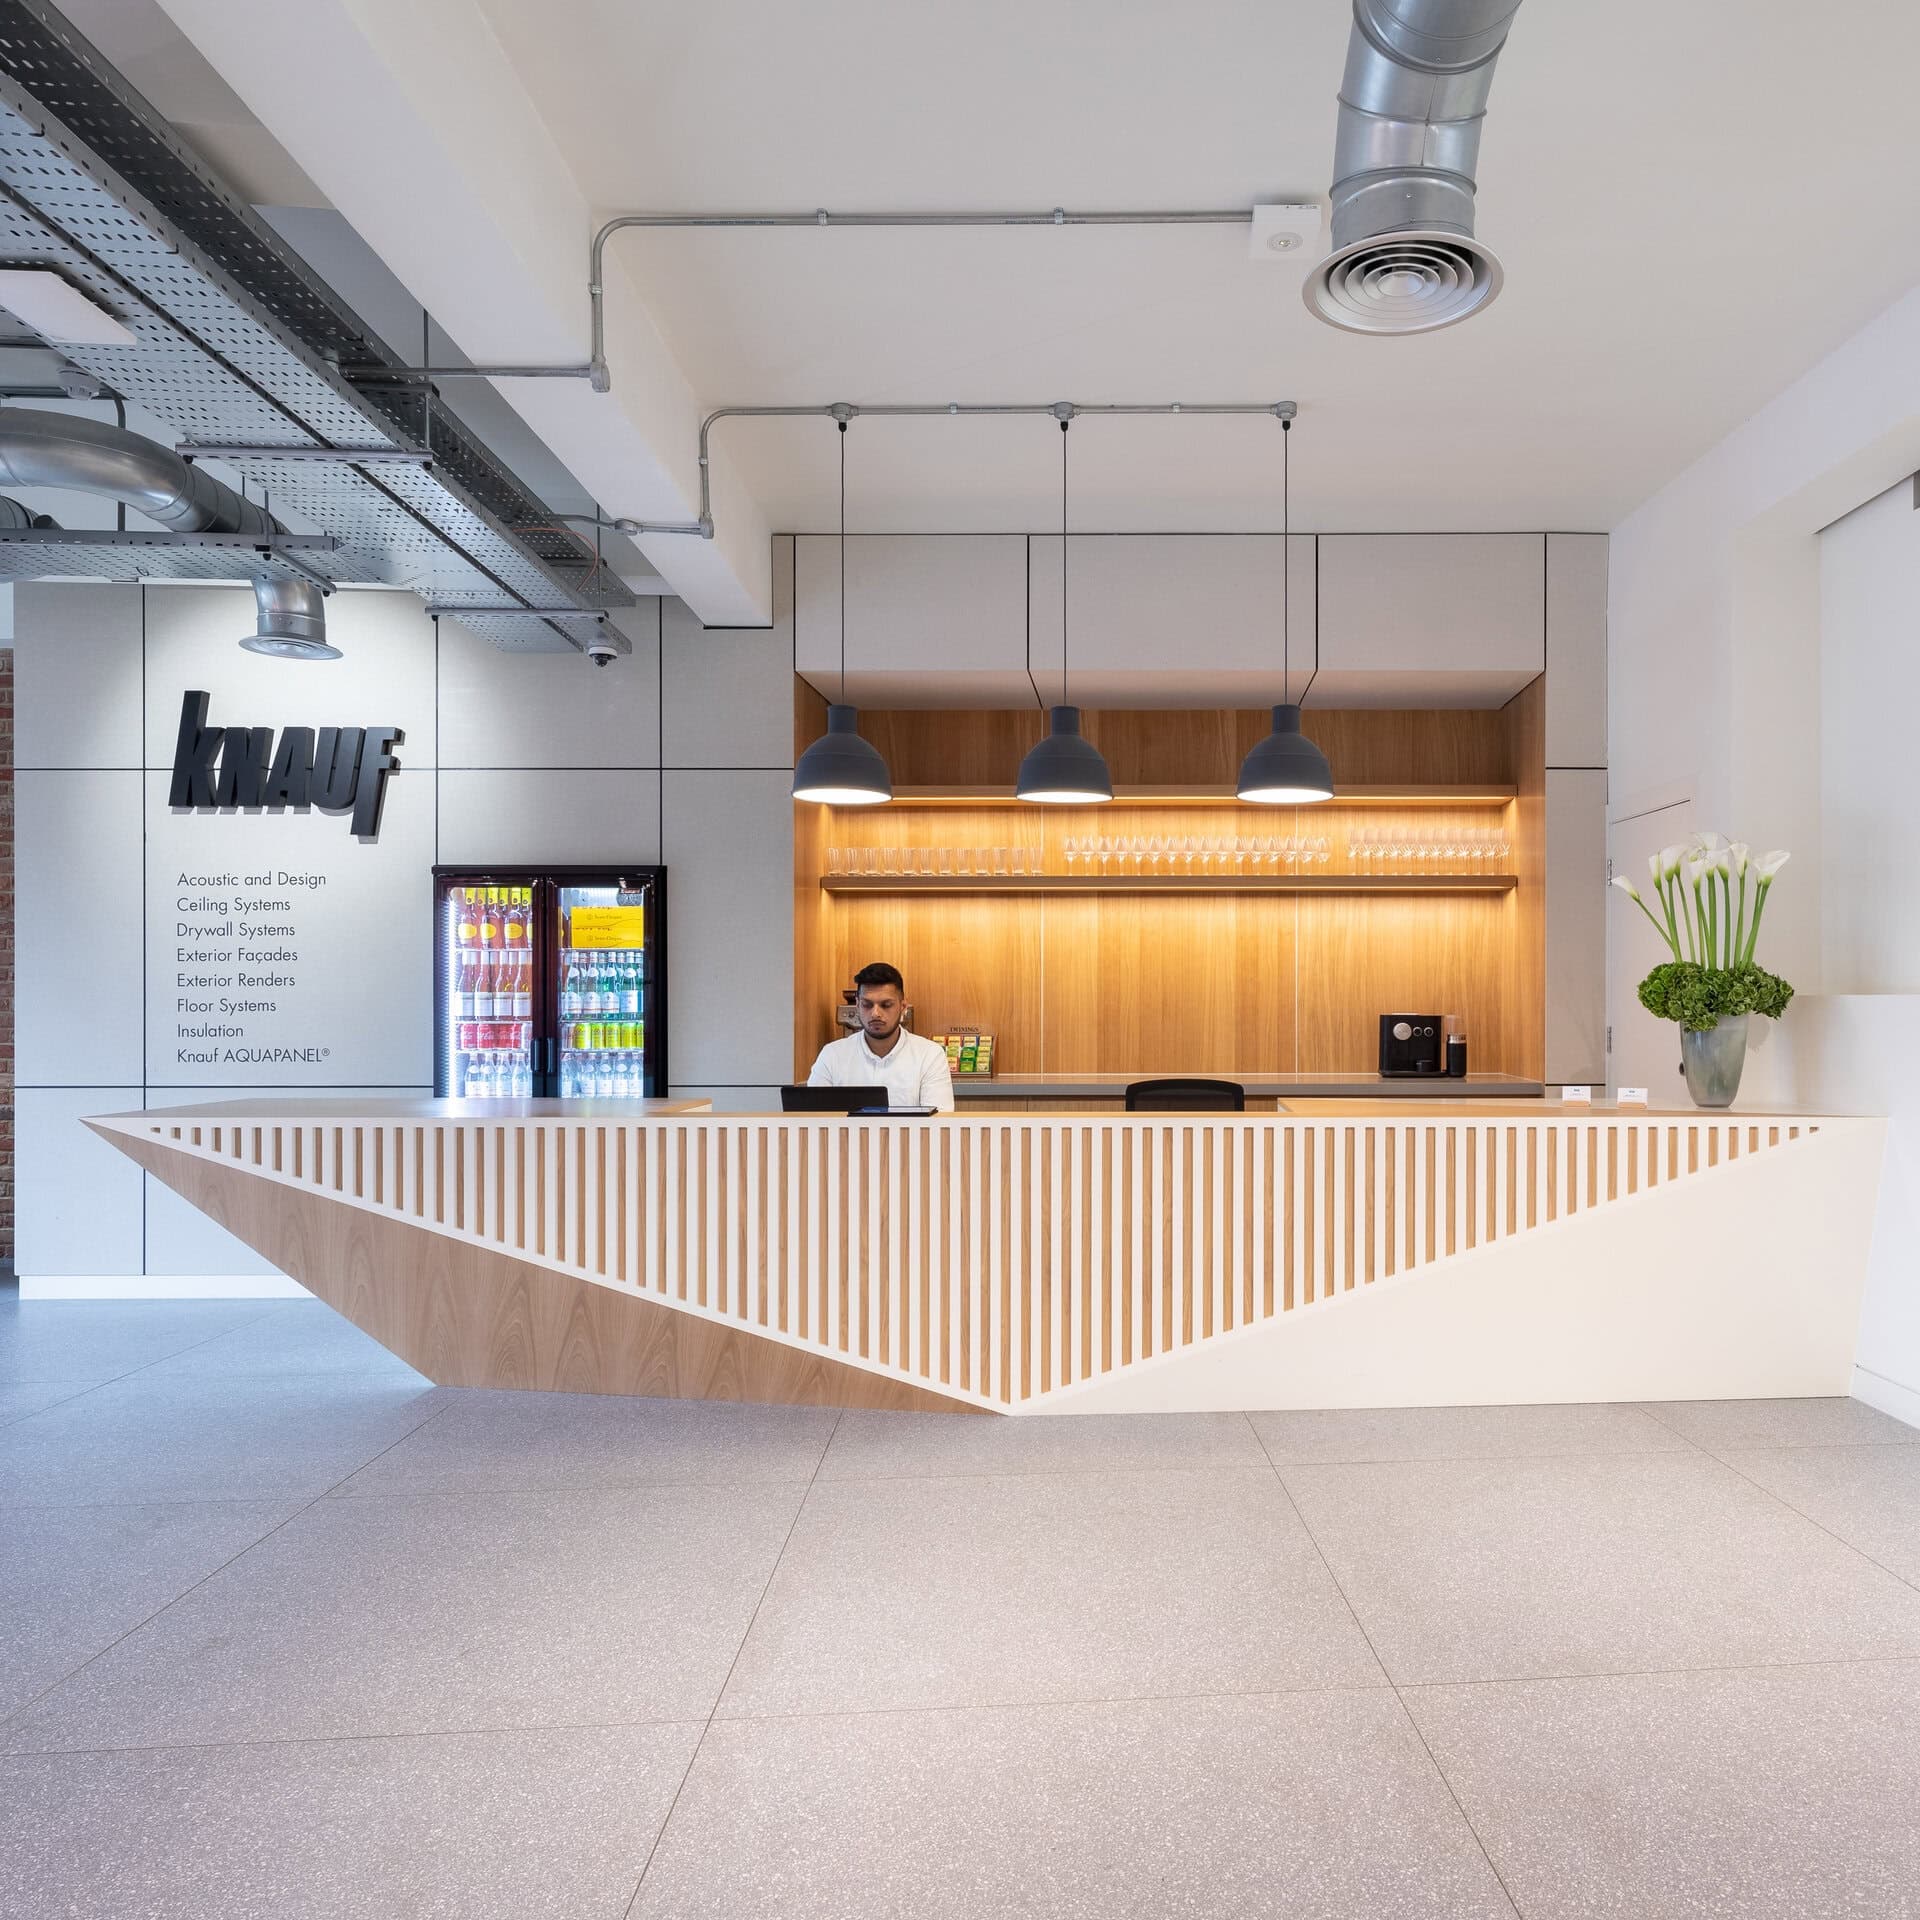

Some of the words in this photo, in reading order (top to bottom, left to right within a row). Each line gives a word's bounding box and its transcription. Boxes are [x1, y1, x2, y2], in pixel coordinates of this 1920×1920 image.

[177, 872, 239, 887] Acoustic
[244, 871, 272, 887] and
[278, 871, 327, 890] Design
[176, 896, 228, 916] Ceiling
[234, 897, 291, 915] Systems
[176, 921, 233, 940] Drywall
[239, 922, 296, 940] Systems
[177, 948, 232, 962] Exterior
[238, 946, 298, 965] Façades
[177, 973, 232, 987] Exterior
[239, 972, 296, 987] Renders
[177, 998, 214, 1013] Floor
[220, 998, 277, 1016] Systems
[177, 1023, 244, 1038] Insulation
[177, 1048, 219, 1063] Knauf
